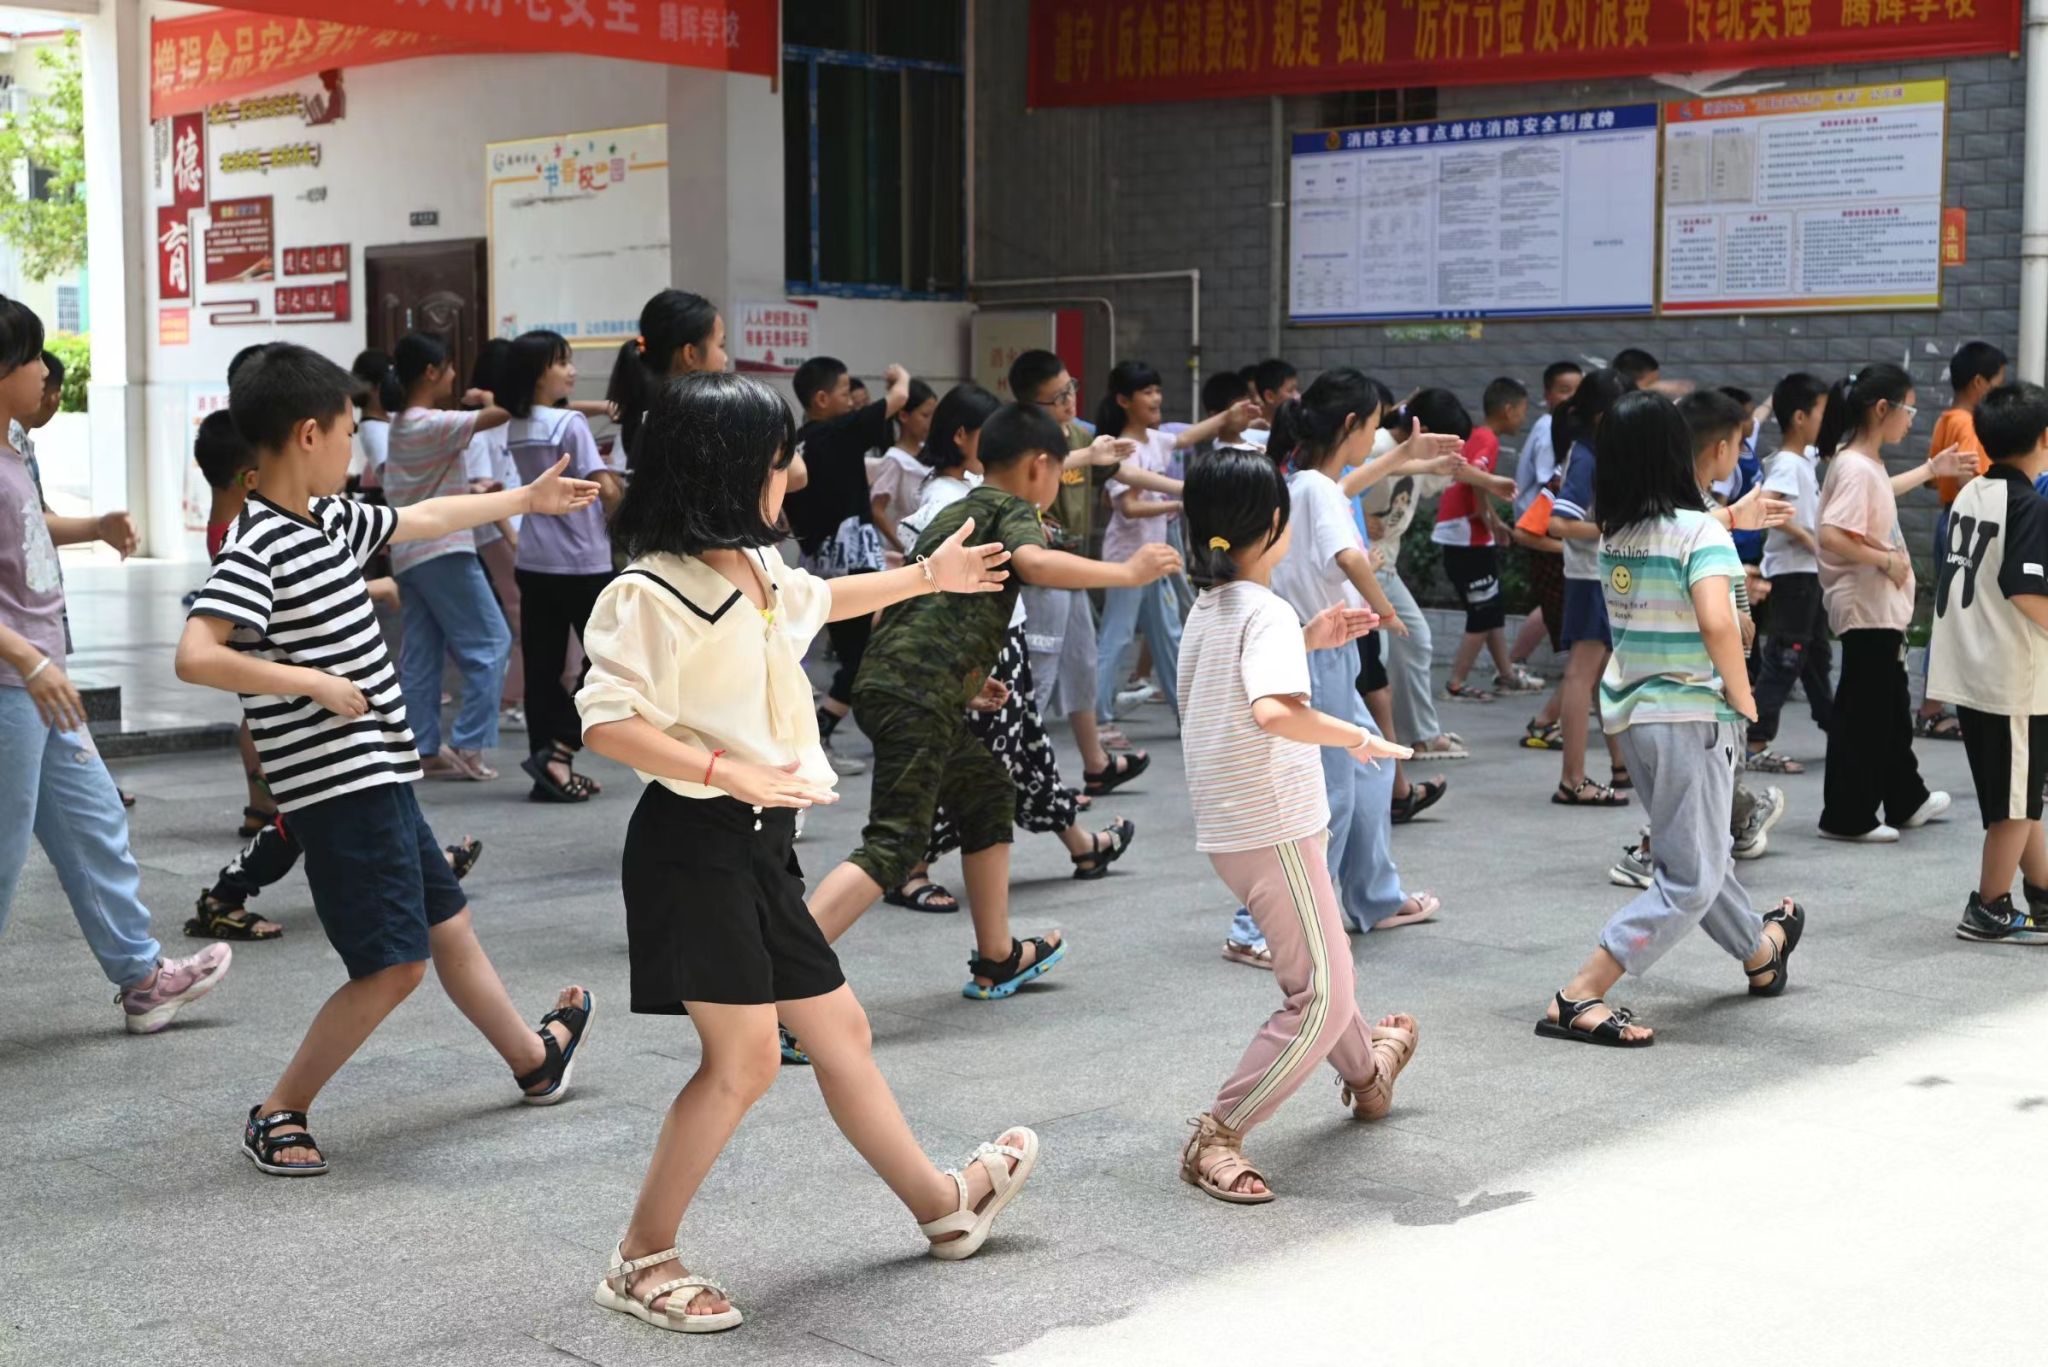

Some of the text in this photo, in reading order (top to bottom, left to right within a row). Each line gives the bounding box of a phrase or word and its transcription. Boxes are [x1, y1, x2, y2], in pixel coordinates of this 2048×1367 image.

[1346, 109, 1616, 149] 消防安全重点单位消防安全制度牌
[1604, 543, 1648, 566] Smiling
